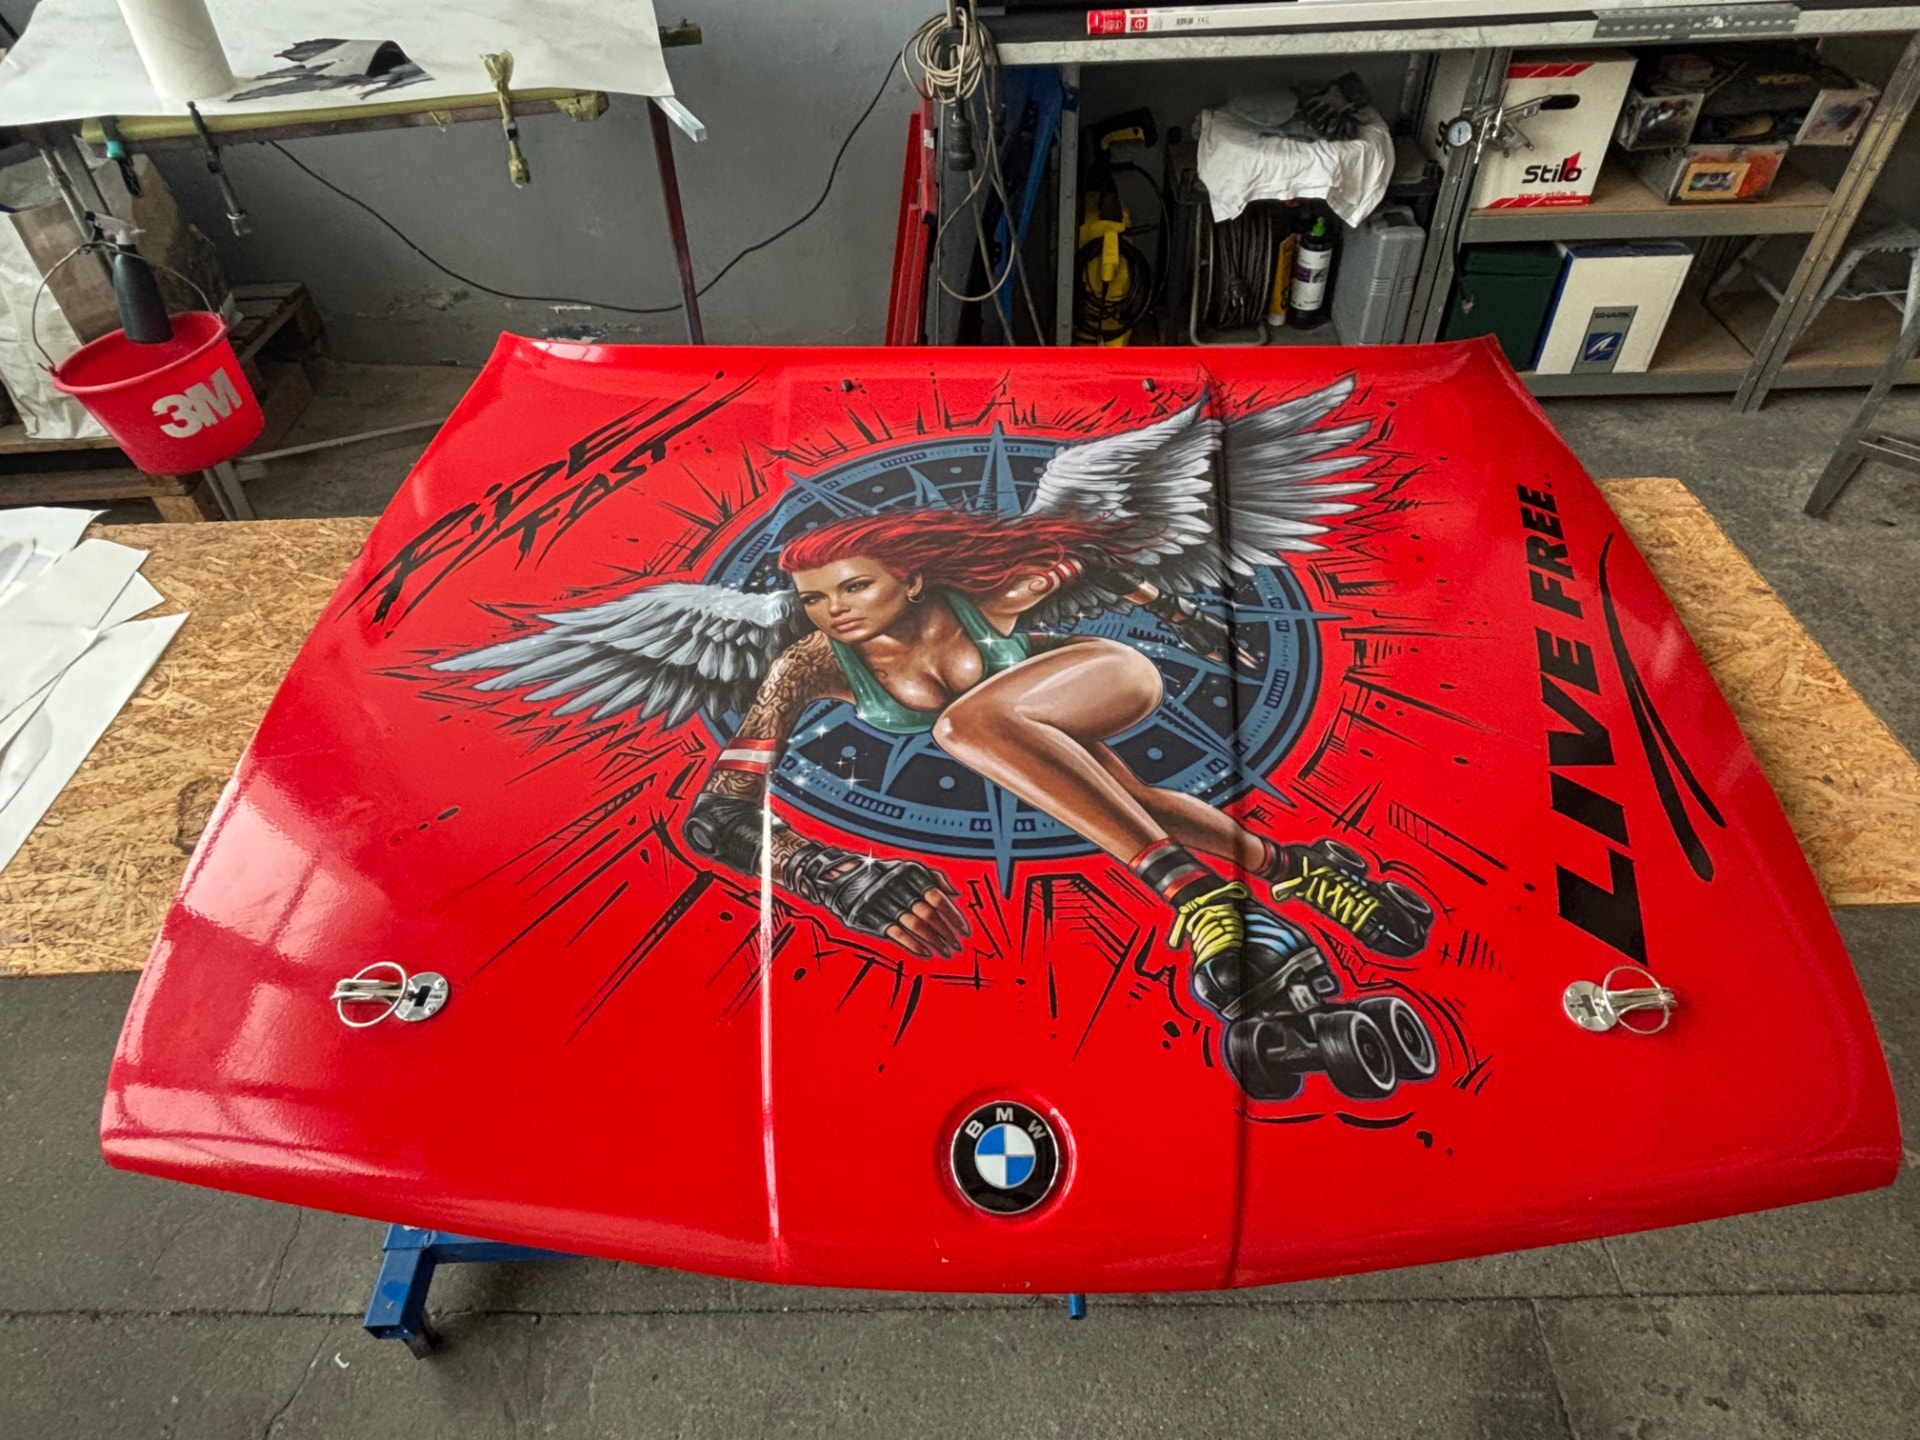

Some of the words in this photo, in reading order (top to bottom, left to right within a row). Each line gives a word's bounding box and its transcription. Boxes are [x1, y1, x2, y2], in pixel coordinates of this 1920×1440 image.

[1522, 152, 1582, 184] Stilo
[151, 366, 243, 438] 3M
[449, 362, 769, 576] FAST
[1535, 625, 1649, 967] LIVE
[964, 1107, 1047, 1140] BMW
